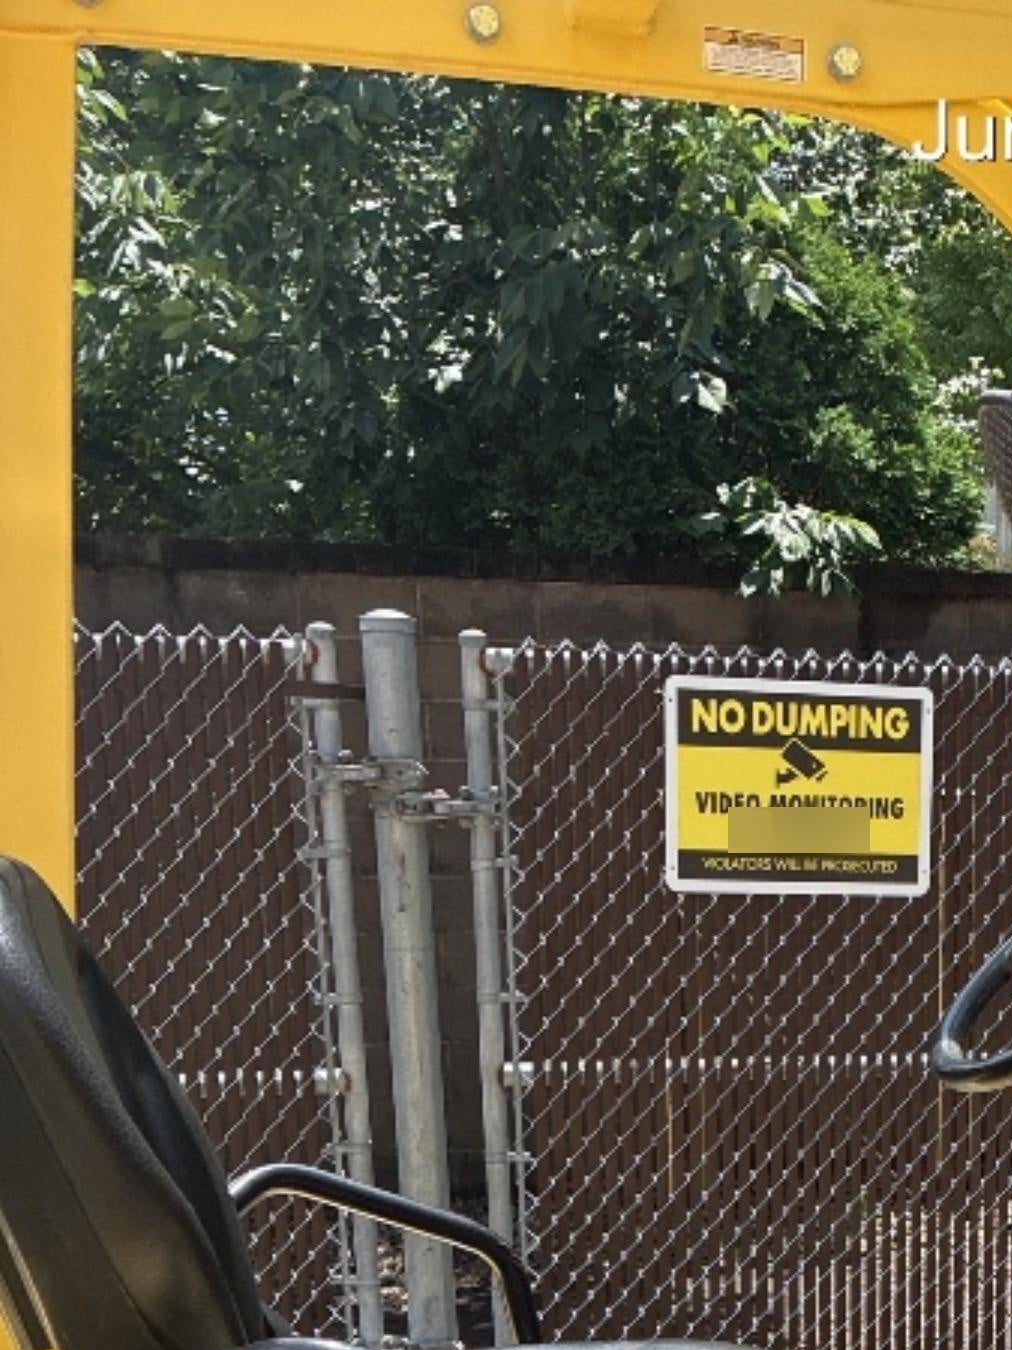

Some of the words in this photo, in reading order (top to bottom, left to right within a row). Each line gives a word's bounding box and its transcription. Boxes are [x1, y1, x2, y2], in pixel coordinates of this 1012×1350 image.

[691, 698, 746, 734] NO
[751, 701, 911, 739] DUMPING
[695, 791, 760, 814] VIDEO
